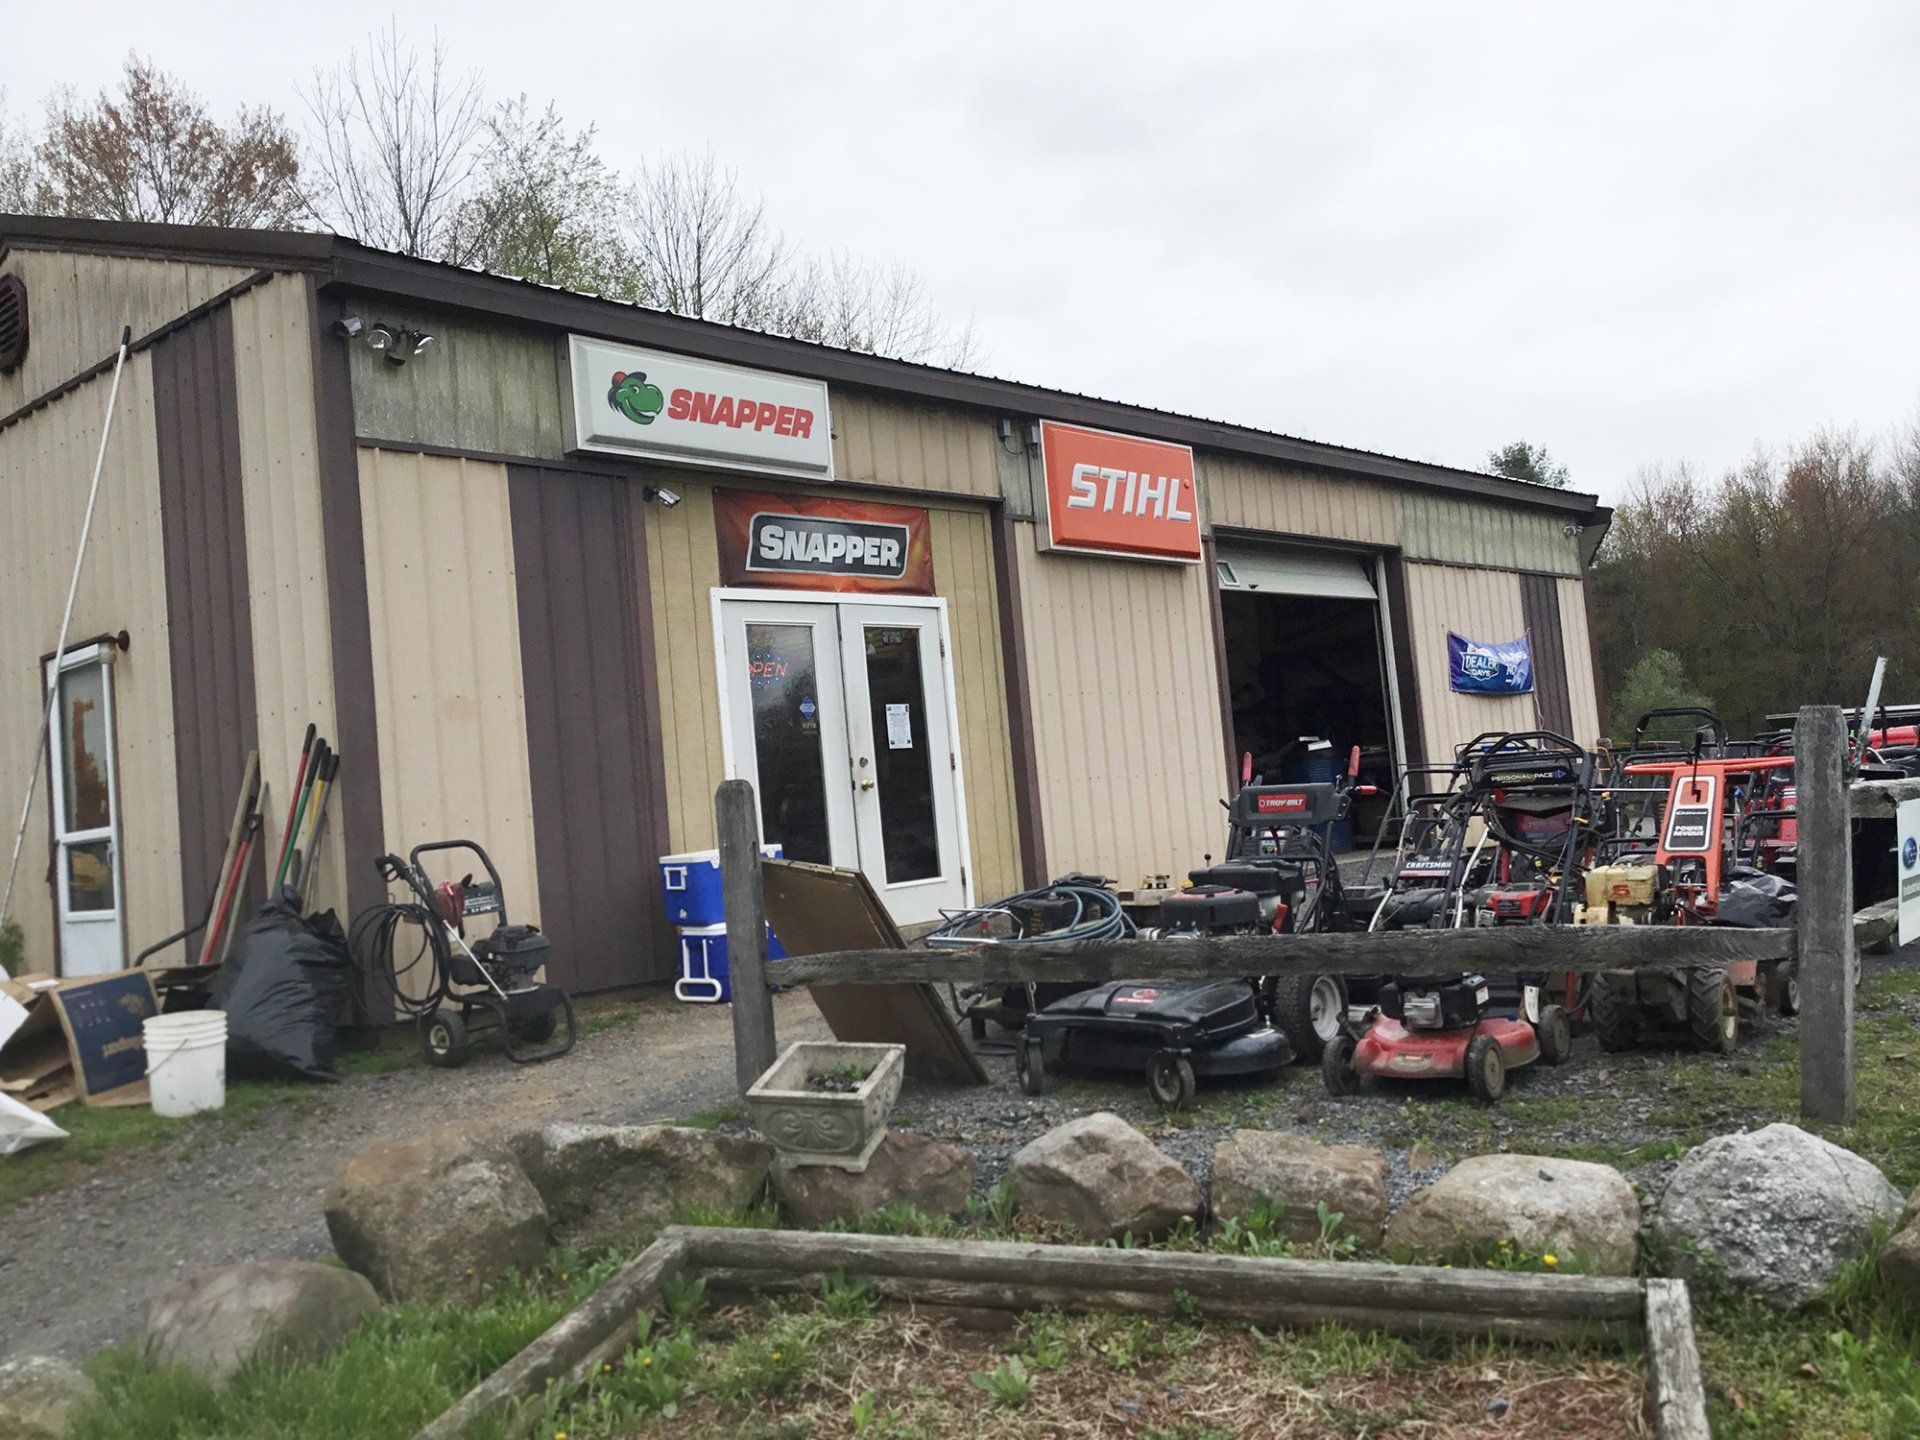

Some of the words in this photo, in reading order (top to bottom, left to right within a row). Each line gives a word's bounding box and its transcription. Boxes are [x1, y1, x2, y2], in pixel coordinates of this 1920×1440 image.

[667, 388, 815, 440] SNAPPER
[1067, 463, 1192, 522] STIHL
[759, 525, 901, 568] SNAPPER
[1465, 654, 1499, 670] DEALER
[1470, 669, 1491, 677] DAYS
[1491, 774, 1532, 782] PERSONAL
[1266, 798, 1304, 807] TROY-BILT
[1405, 861, 1452, 869] CRAFTSMAN
